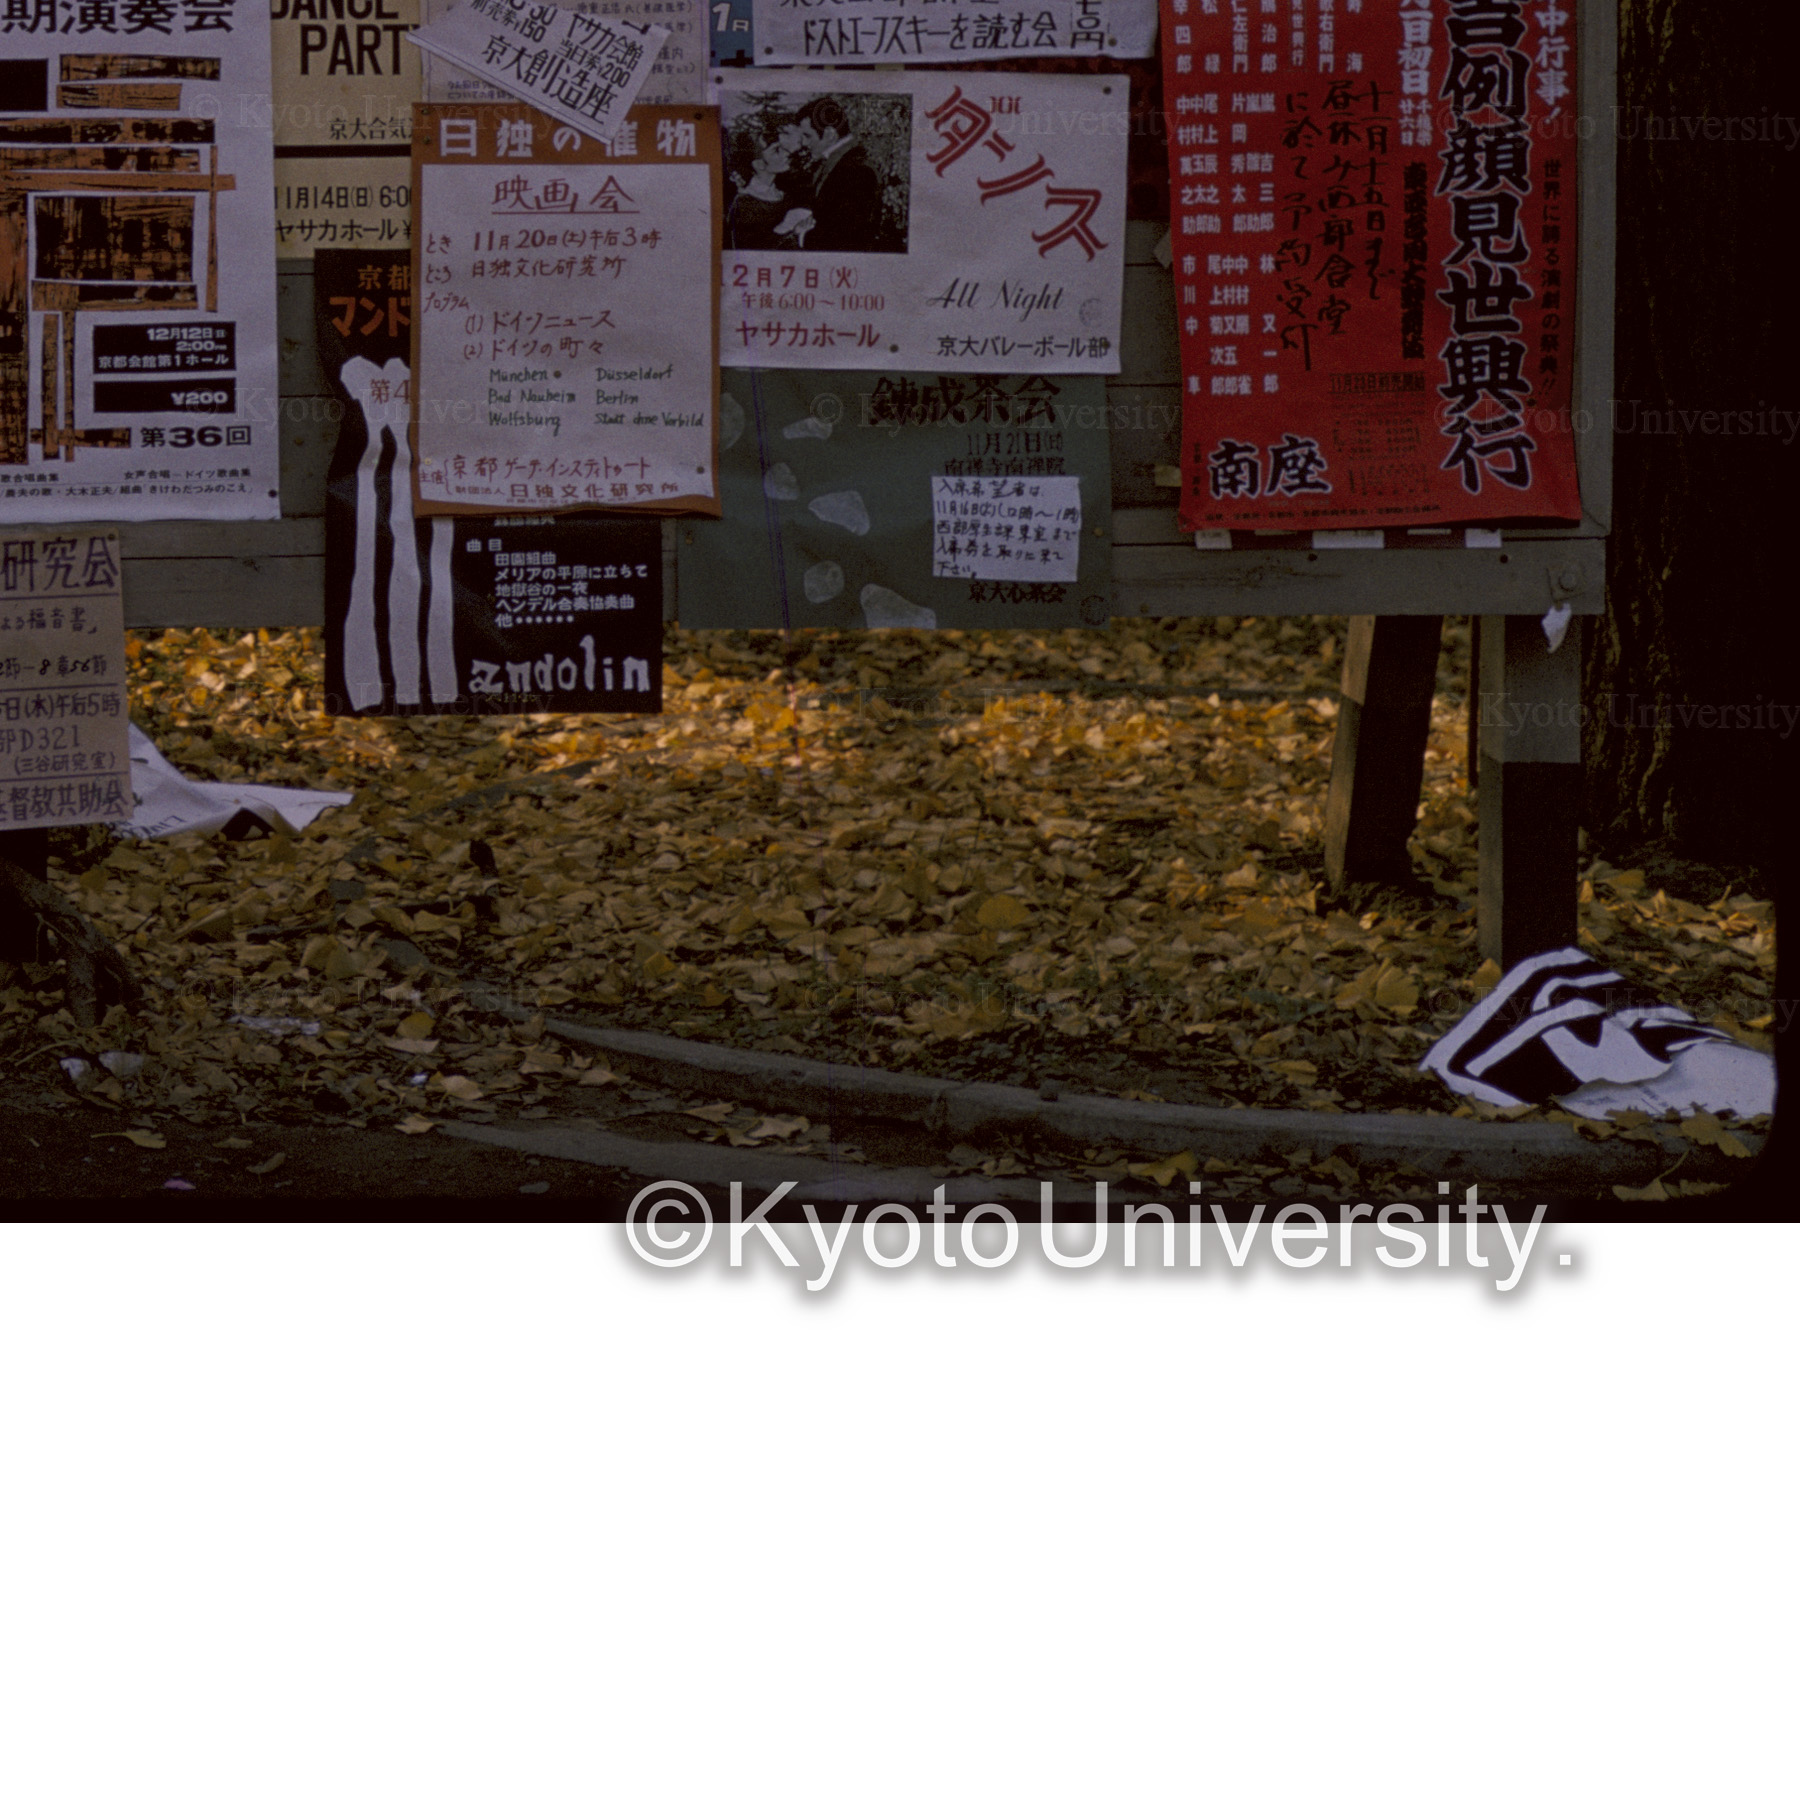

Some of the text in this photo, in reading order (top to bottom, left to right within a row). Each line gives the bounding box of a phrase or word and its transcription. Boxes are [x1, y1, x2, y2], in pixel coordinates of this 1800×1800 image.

[481, 34, 618, 125] 京大創造座
[924, 84, 1109, 263] ダンス
[492, 174, 637, 213] 映画会
[275, 219, 399, 241] ヤサカホール
[471, 256, 626, 280] 日独文化研究所
[926, 276, 1064, 322] All Night
[492, 311, 616, 334] ドイツニュース
[735, 320, 880, 348] ヤサカホール
[936, 335, 1110, 358] 京大バレーボール部
[596, 388, 639, 405] Berlin
[140, 425, 251, 448] 第36回
[1208, 433, 1333, 498] 南座
